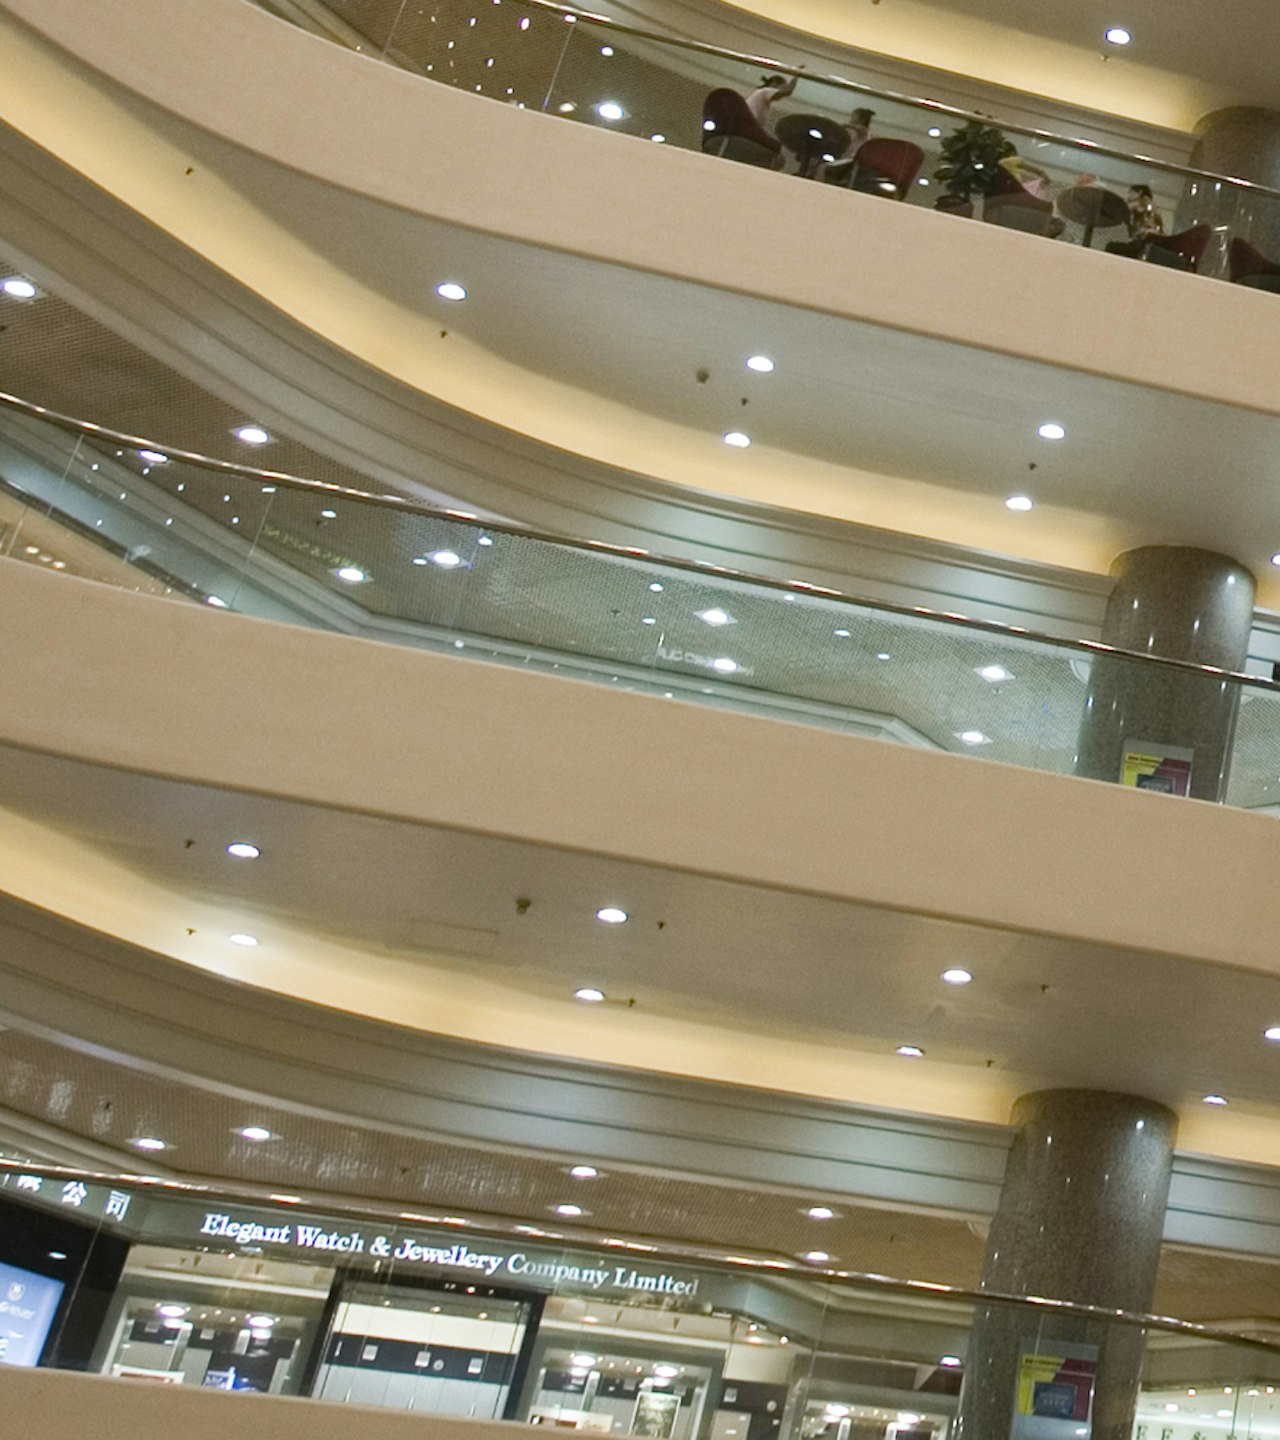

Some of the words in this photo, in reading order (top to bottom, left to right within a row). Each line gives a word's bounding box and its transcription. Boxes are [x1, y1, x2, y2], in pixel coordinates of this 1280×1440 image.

[200, 1213, 291, 1244] Elegant
[297, 1224, 364, 1254] Watch
[369, 1235, 391, 1257] &
[394, 1239, 504, 1276] Jewellery
[508, 1253, 610, 1289] Company
[613, 1266, 699, 1297] Limited
